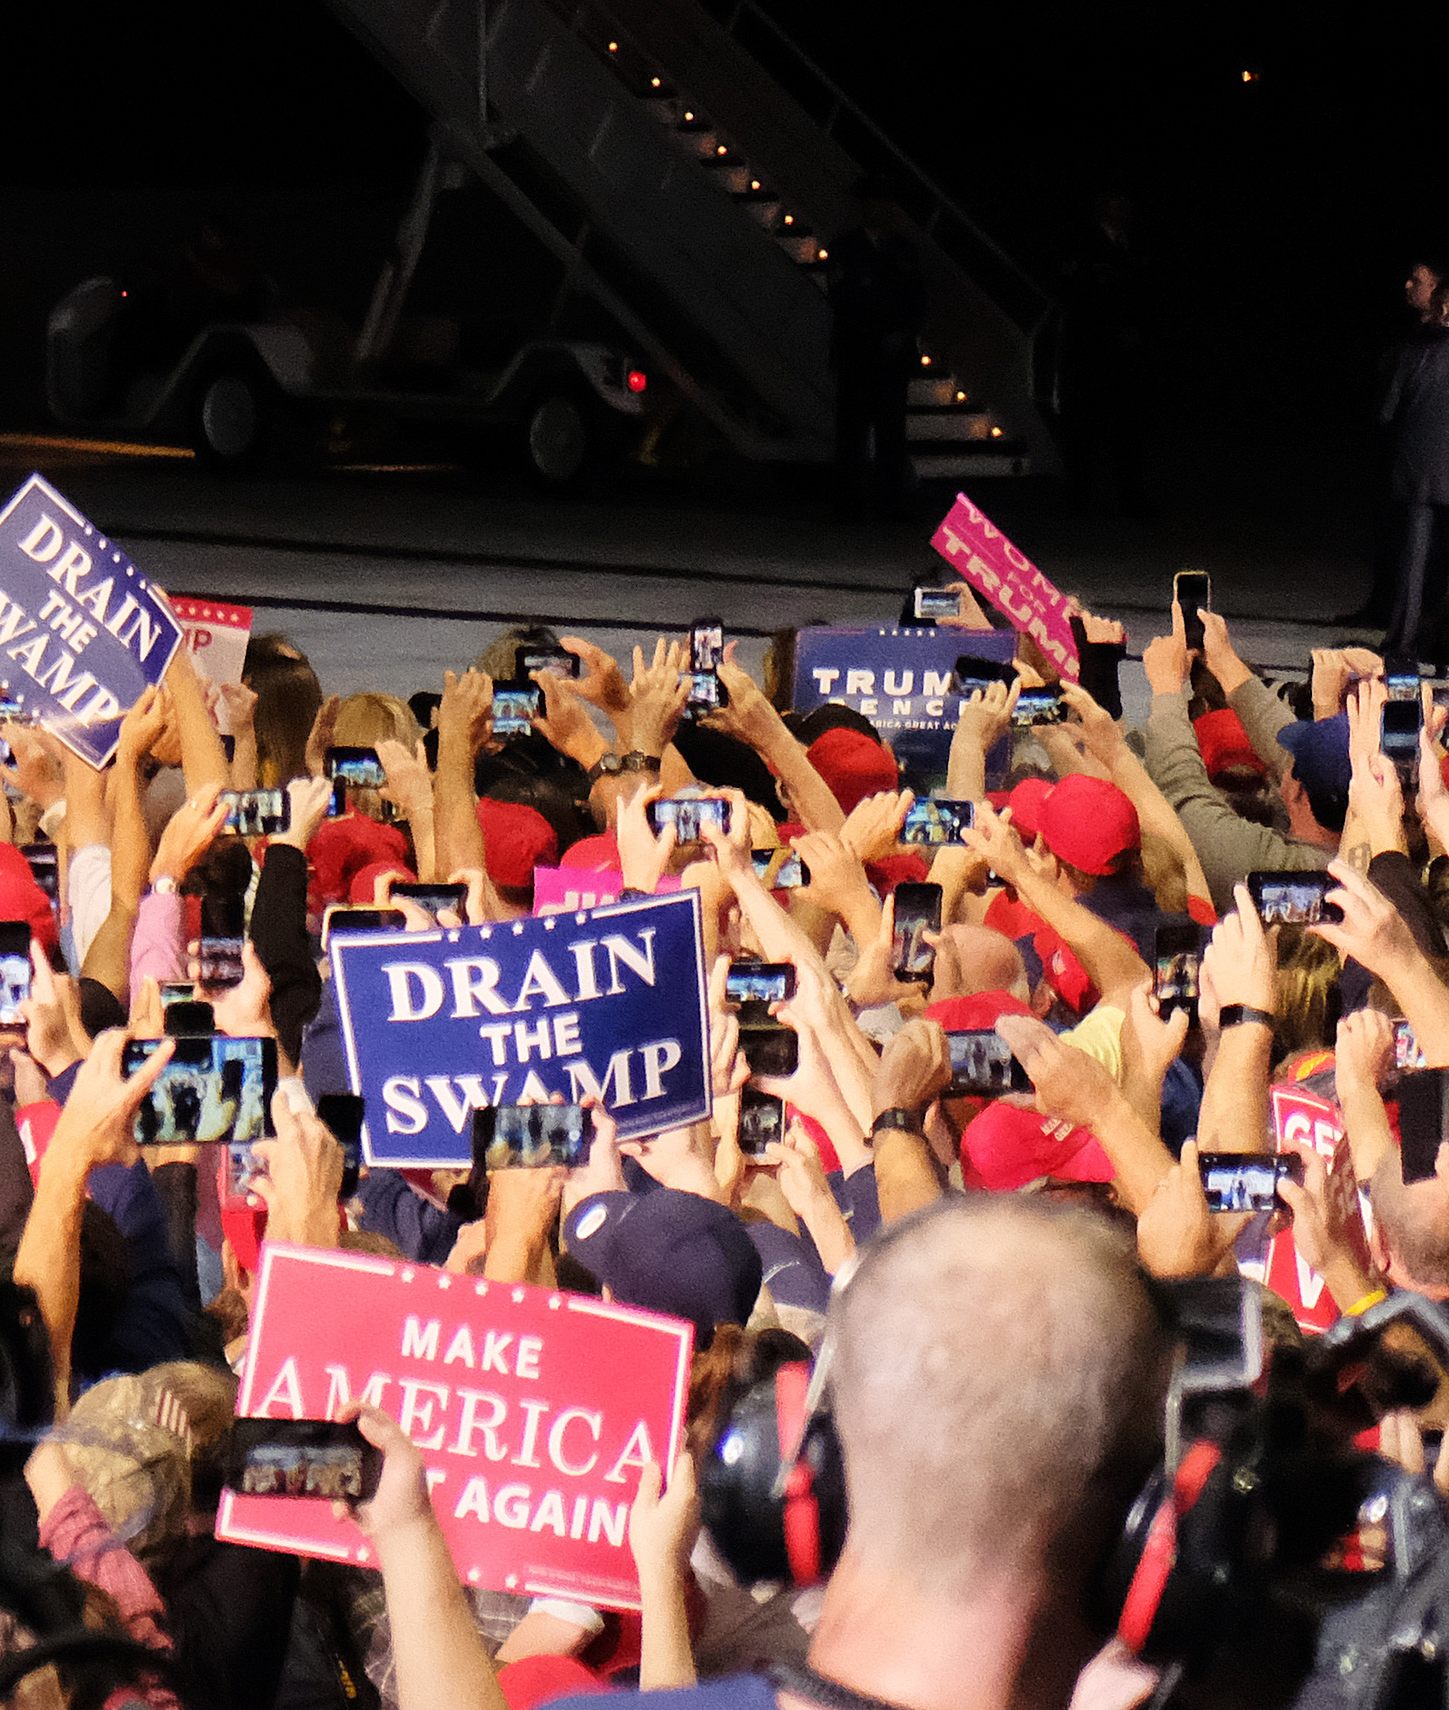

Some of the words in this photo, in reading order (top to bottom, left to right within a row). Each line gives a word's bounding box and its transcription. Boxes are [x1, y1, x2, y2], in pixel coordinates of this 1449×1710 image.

[16, 512, 163, 663] DRAIN
[38, 588, 99, 654] THE
[812, 666, 953, 696] TRUM
[381, 927, 657, 1023] DRAIN
[479, 1011, 583, 1067] THE
[400, 1315, 545, 1380] MAKE
[257, 1354, 657, 1484] AMERICA
[454, 1473, 629, 1548] AGAIN
